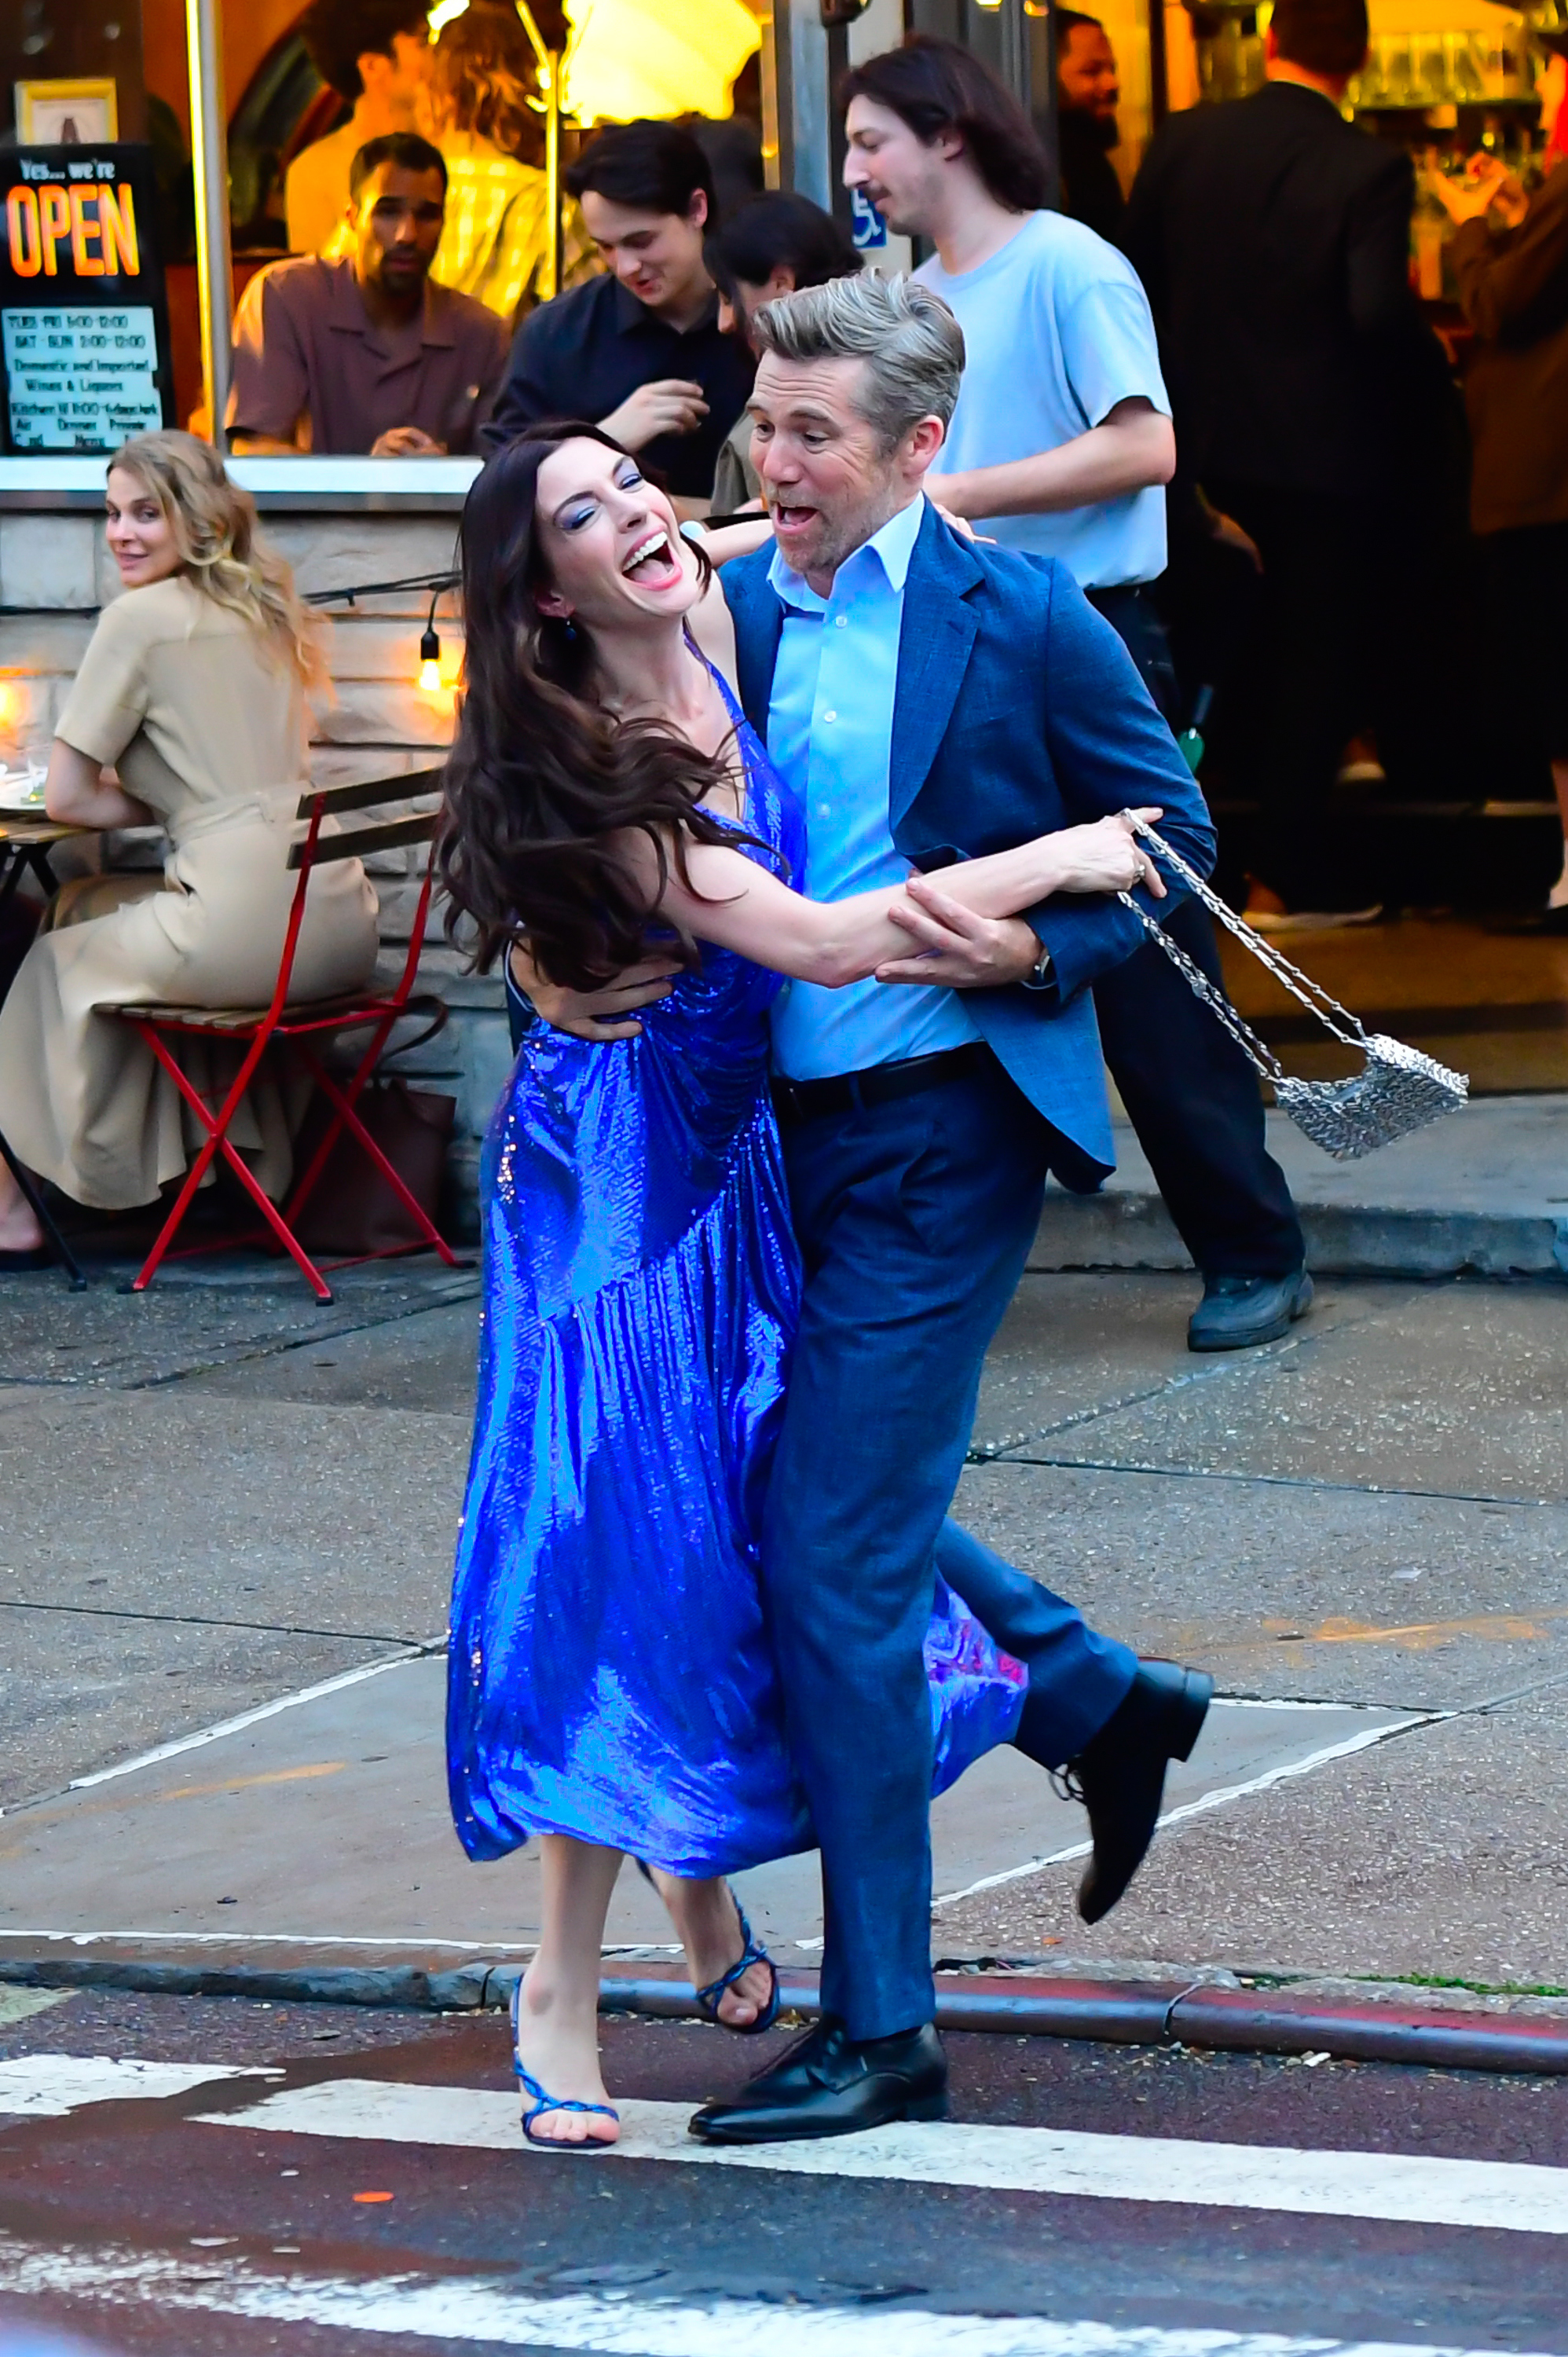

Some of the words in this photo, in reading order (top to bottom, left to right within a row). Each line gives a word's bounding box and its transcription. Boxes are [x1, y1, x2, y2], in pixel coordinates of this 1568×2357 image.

[20, 159, 65, 180] Yes...
[68, 157, 115, 179] we're
[6, 182, 140, 277] OPEN
